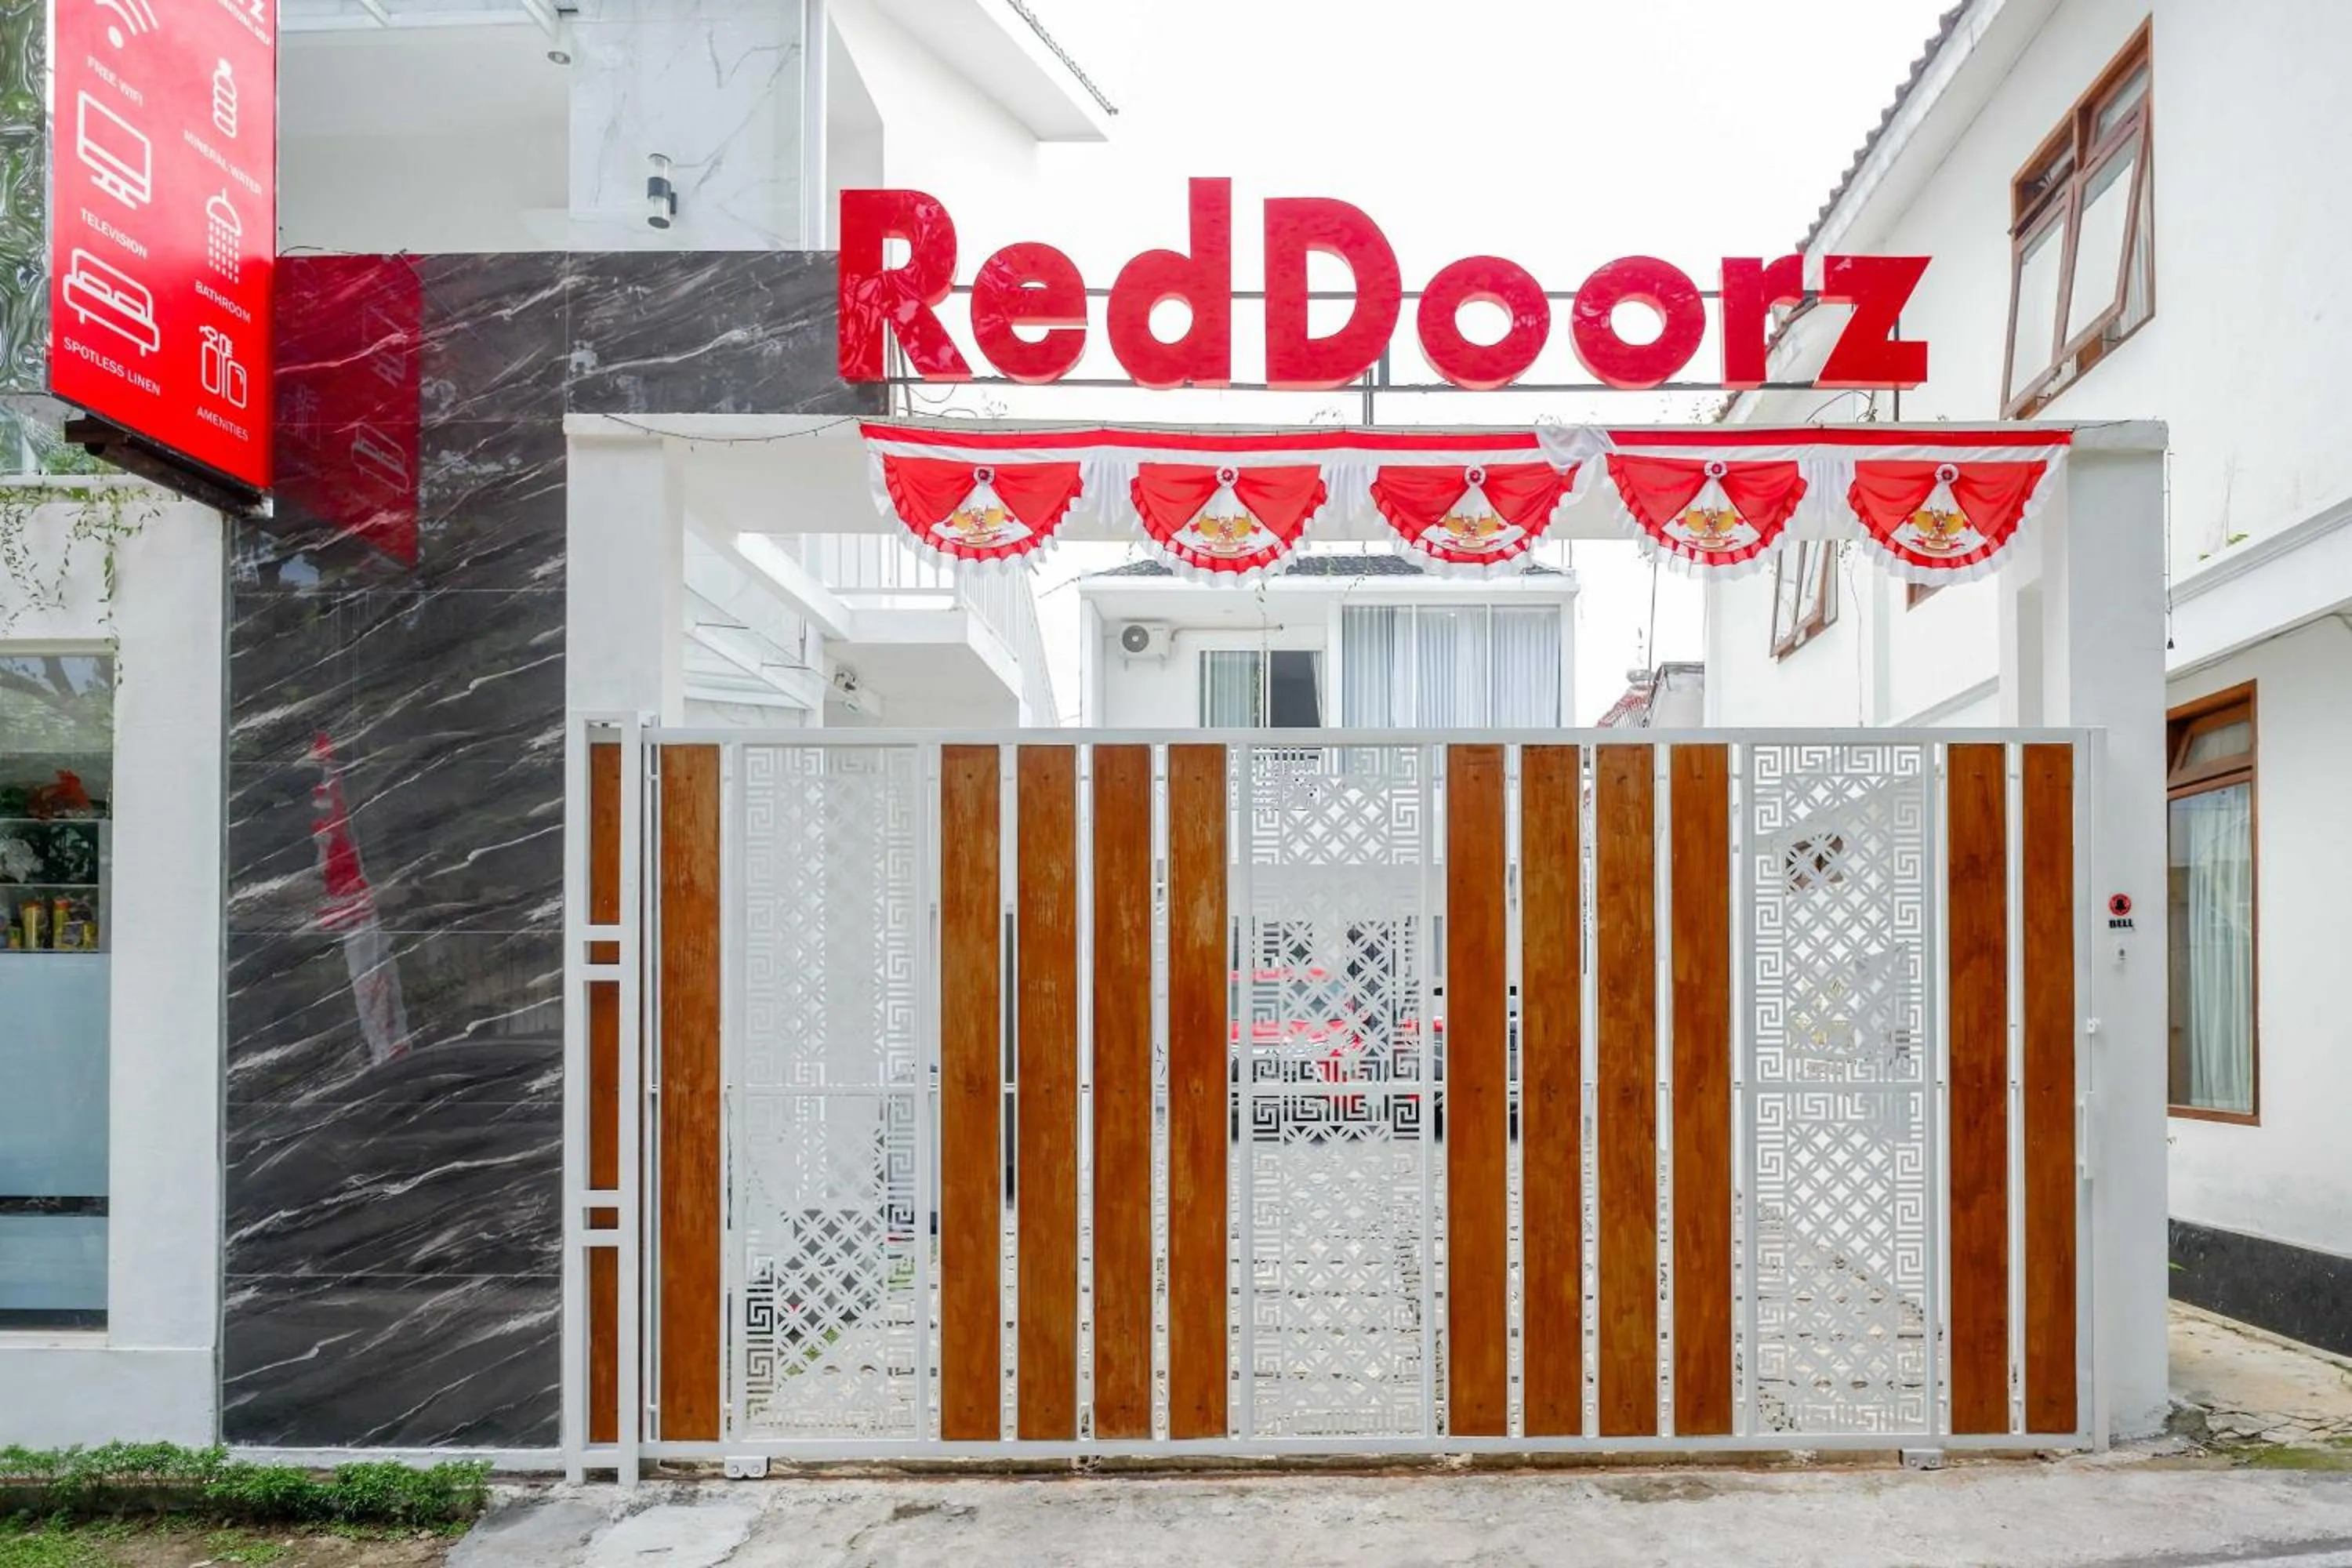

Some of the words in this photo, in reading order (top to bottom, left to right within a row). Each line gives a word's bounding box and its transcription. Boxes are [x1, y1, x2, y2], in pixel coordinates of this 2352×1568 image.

[81, 207, 147, 260] TELEVISION
[195, 280, 251, 324] BATHROOM
[839, 177, 1932, 390] RedDoorz
[64, 336, 125, 377] SPOTLESS
[127, 369, 161, 396] LINEN
[197, 405, 249, 442] AMENITIES
